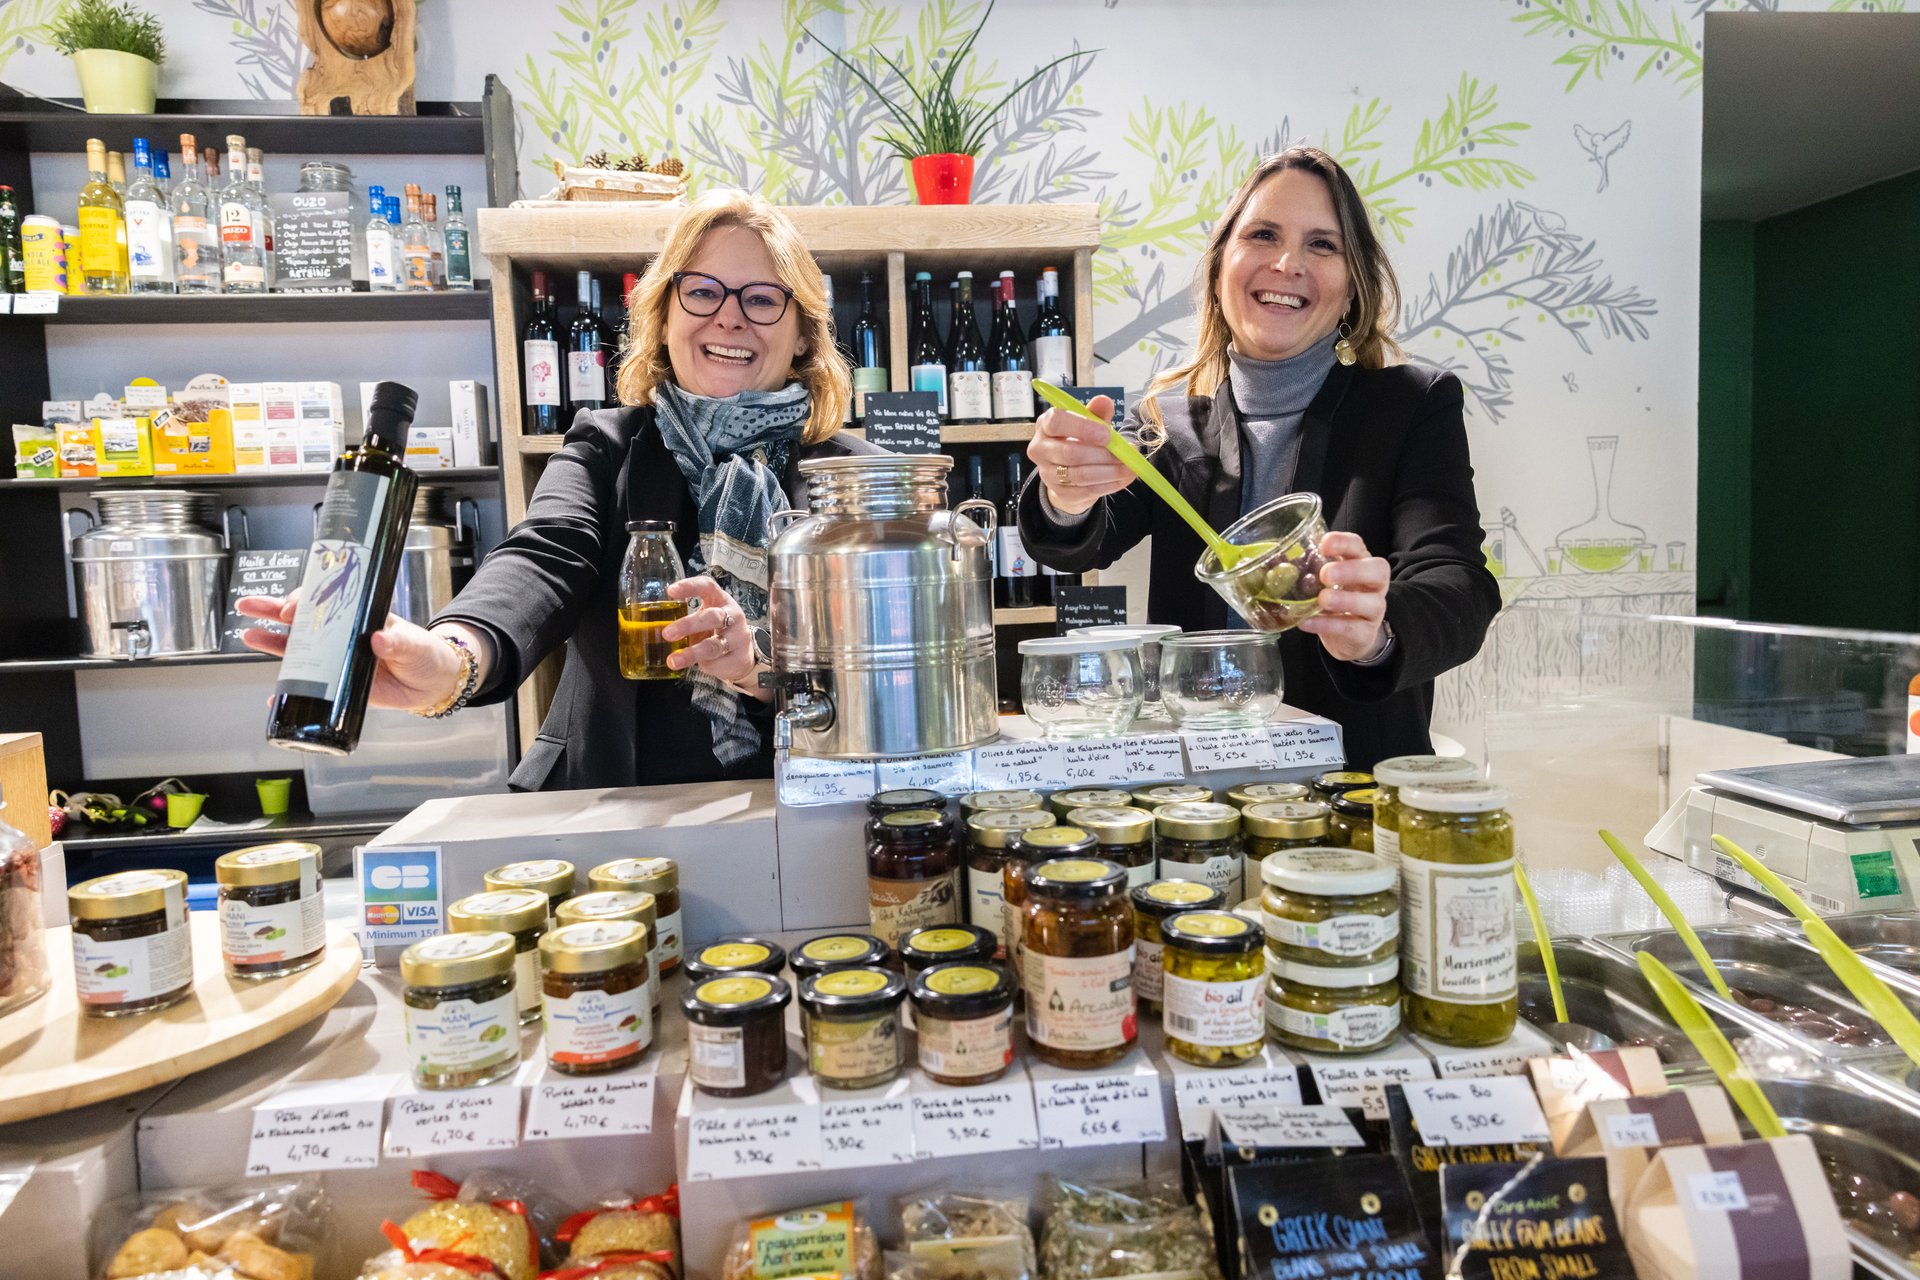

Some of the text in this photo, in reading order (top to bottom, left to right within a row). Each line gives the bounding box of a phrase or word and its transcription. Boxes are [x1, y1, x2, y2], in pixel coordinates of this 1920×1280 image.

[292, 197, 326, 207] OUZO
[243, 571, 286, 580] en vrac
[981, 750, 1004, 759] Olives
[1006, 748, 1014, 756] de
[1006, 770, 1042, 784] 4,85€
[1066, 768, 1096, 779] 6,40€
[371, 864, 430, 890] CB
[406, 905, 436, 917] VISA
[366, 928, 439, 939] Minimum 15€
[1205, 987, 1244, 1004] bio ail
[1318, 1067, 1359, 1080] Feuilles
[1364, 1067, 1377, 1078] de
[584, 1084, 597, 1096] de
[1424, 1083, 1493, 1101] Fava Bio
